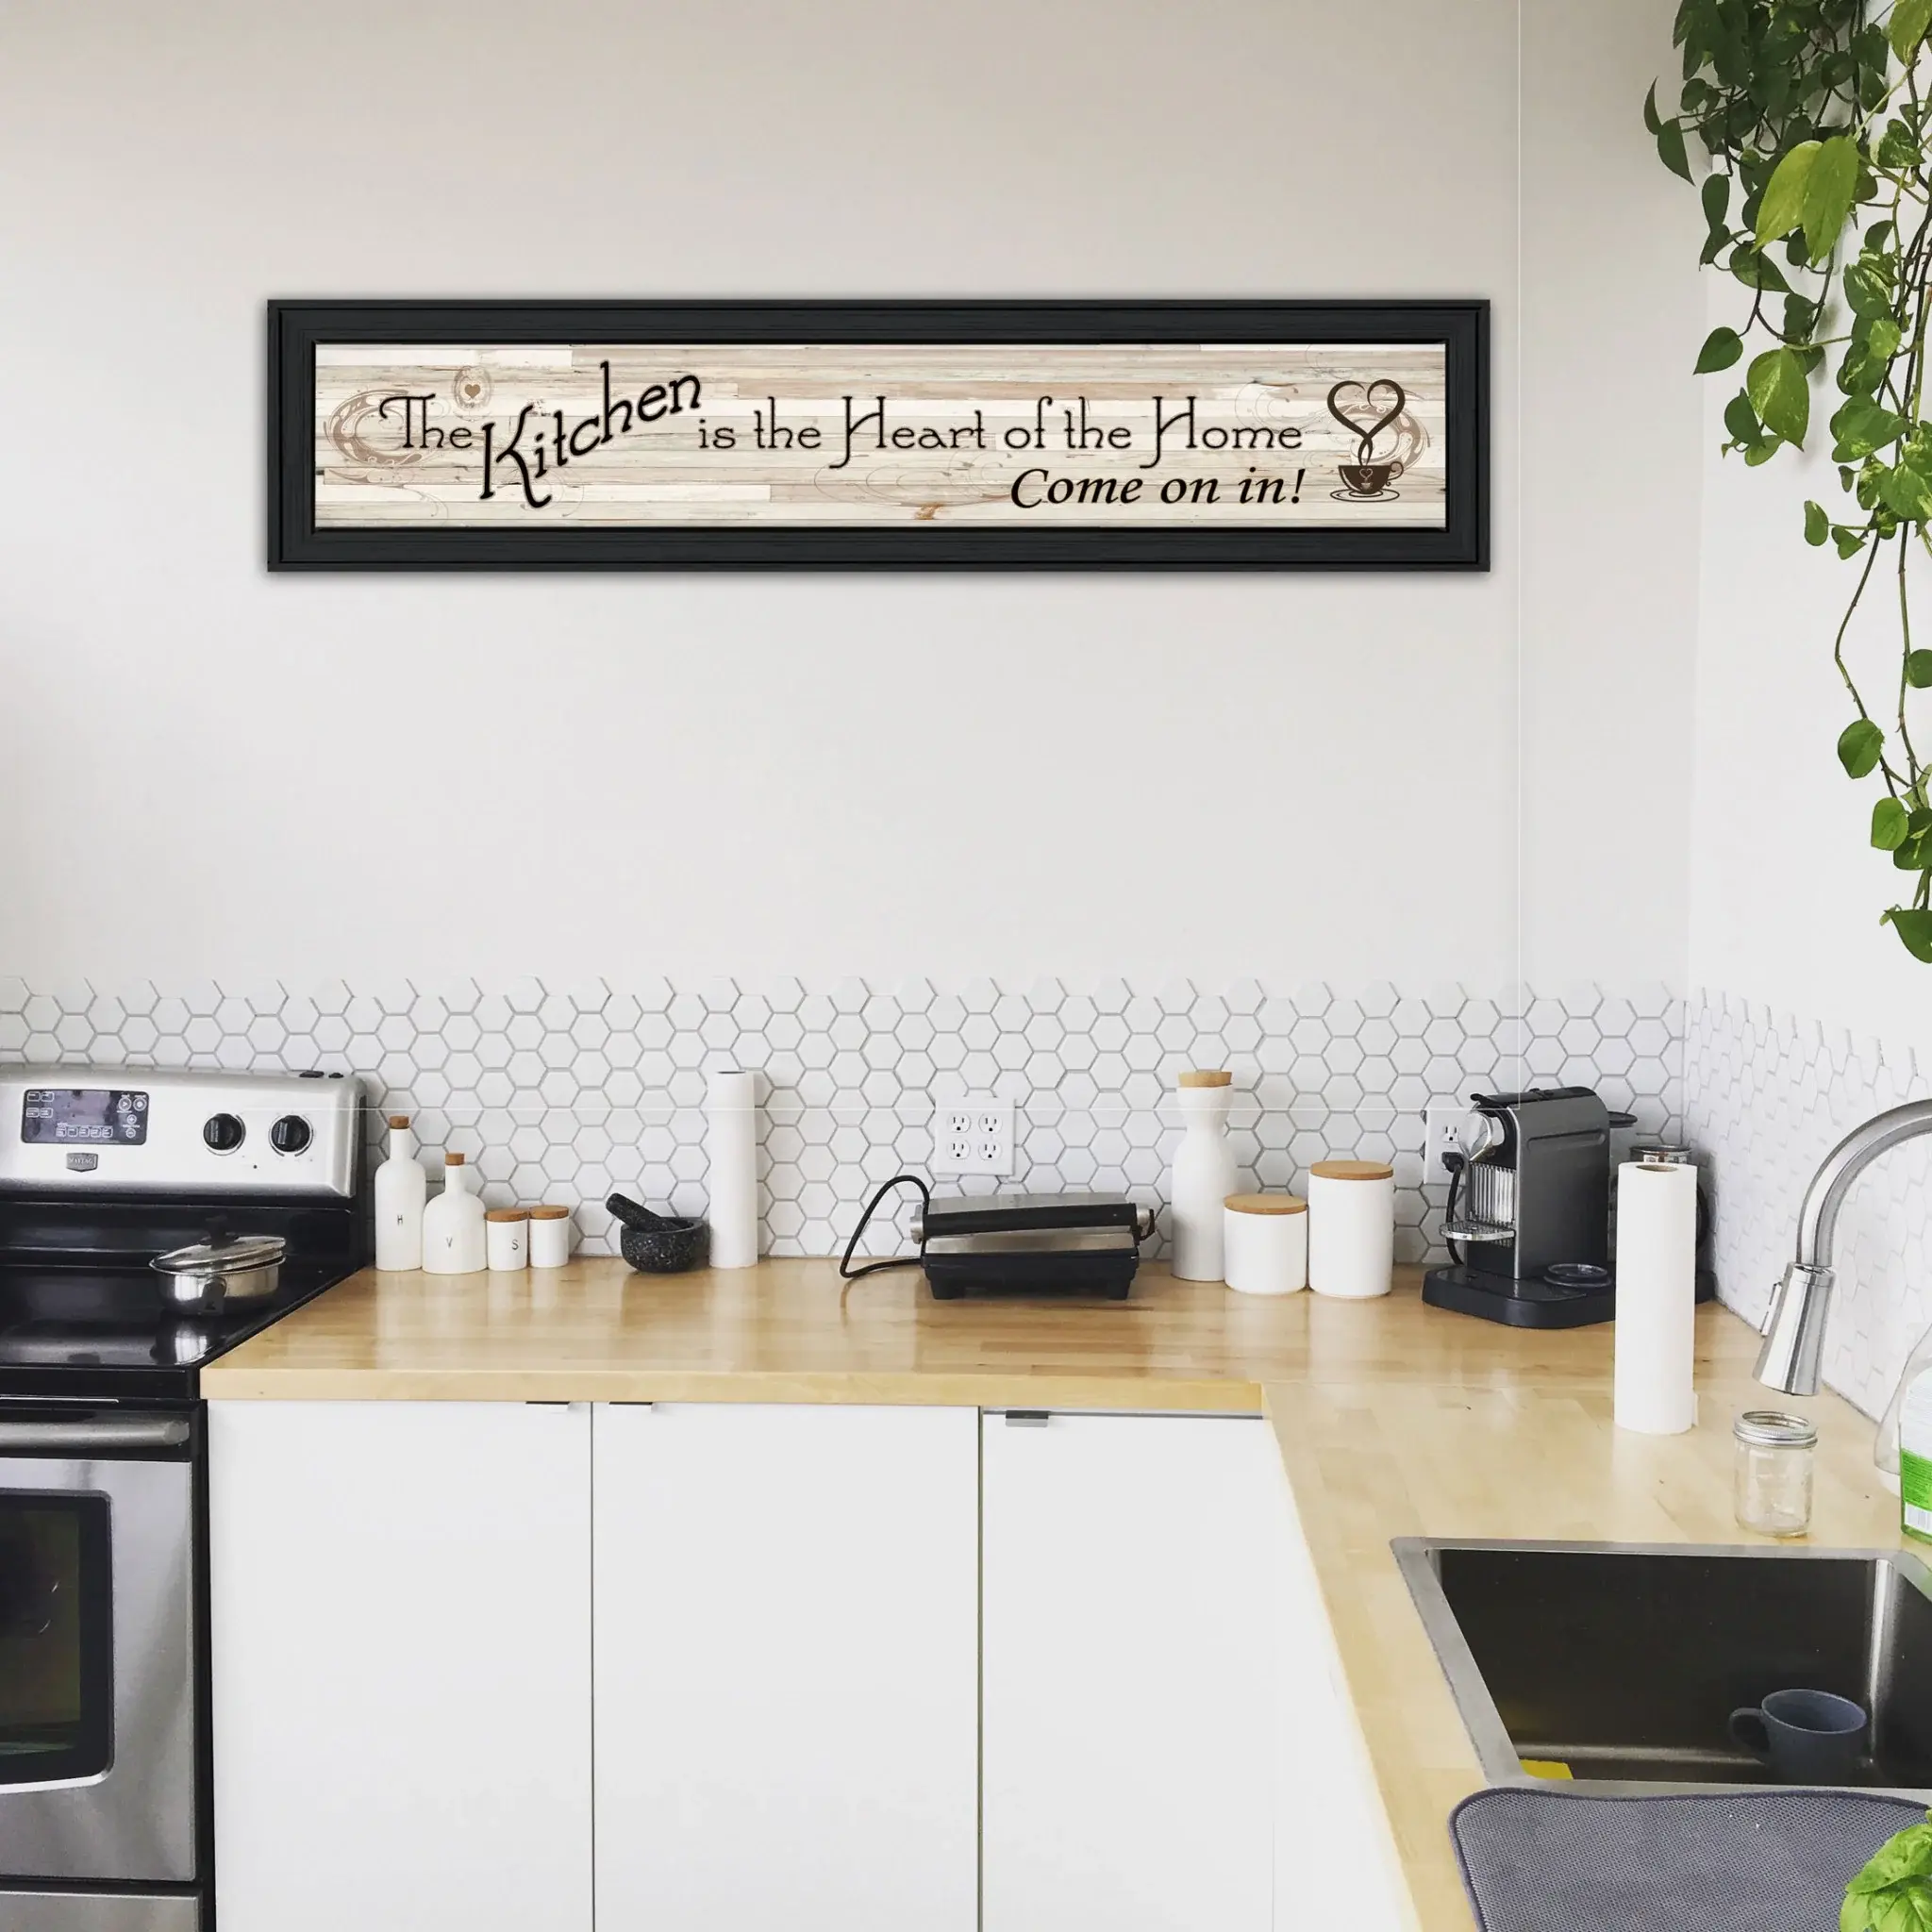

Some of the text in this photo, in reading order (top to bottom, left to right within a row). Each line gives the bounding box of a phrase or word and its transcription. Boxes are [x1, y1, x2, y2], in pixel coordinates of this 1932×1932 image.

[378, 360, 1303, 509] The Kitchen is the Heart of the Home
[1010, 466, 1306, 509] Come on in!
[396, 1214, 404, 1226] H
[445, 1237, 454, 1249] V
[511, 1239, 520, 1251] S
